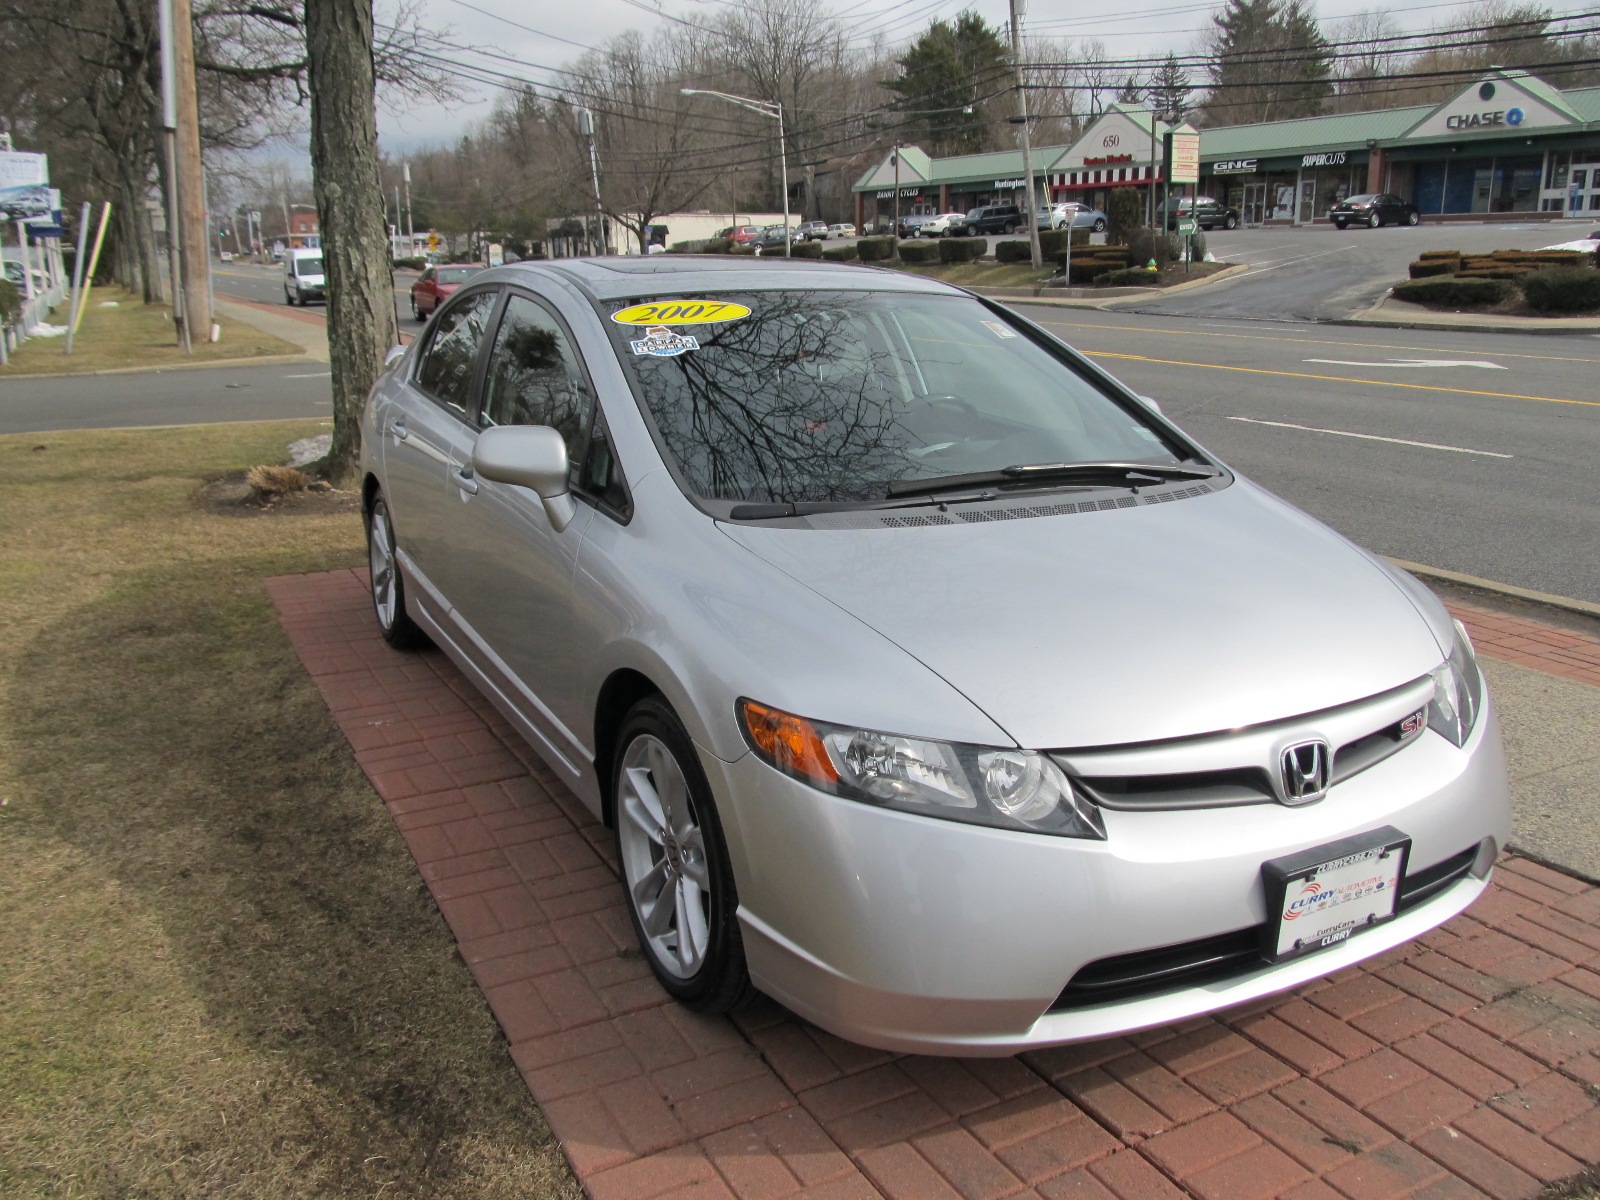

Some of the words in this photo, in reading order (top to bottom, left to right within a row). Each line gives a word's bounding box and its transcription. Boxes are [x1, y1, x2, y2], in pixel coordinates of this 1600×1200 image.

[1446, 111, 1505, 129] CHASE
[1103, 134, 1120, 148] 650
[1213, 159, 1258, 170] GNC
[1301, 152, 1346, 167] SUPERCUTS
[1179, 223, 1193, 231] ENTER
[630, 304, 728, 322] 2007
[636, 338, 695, 347] CARFAX
[648, 343, 695, 351] OWNER
[1401, 711, 1423, 739] Si
[1290, 888, 1338, 910] CURRY
[1321, 927, 1353, 947] CURRY
